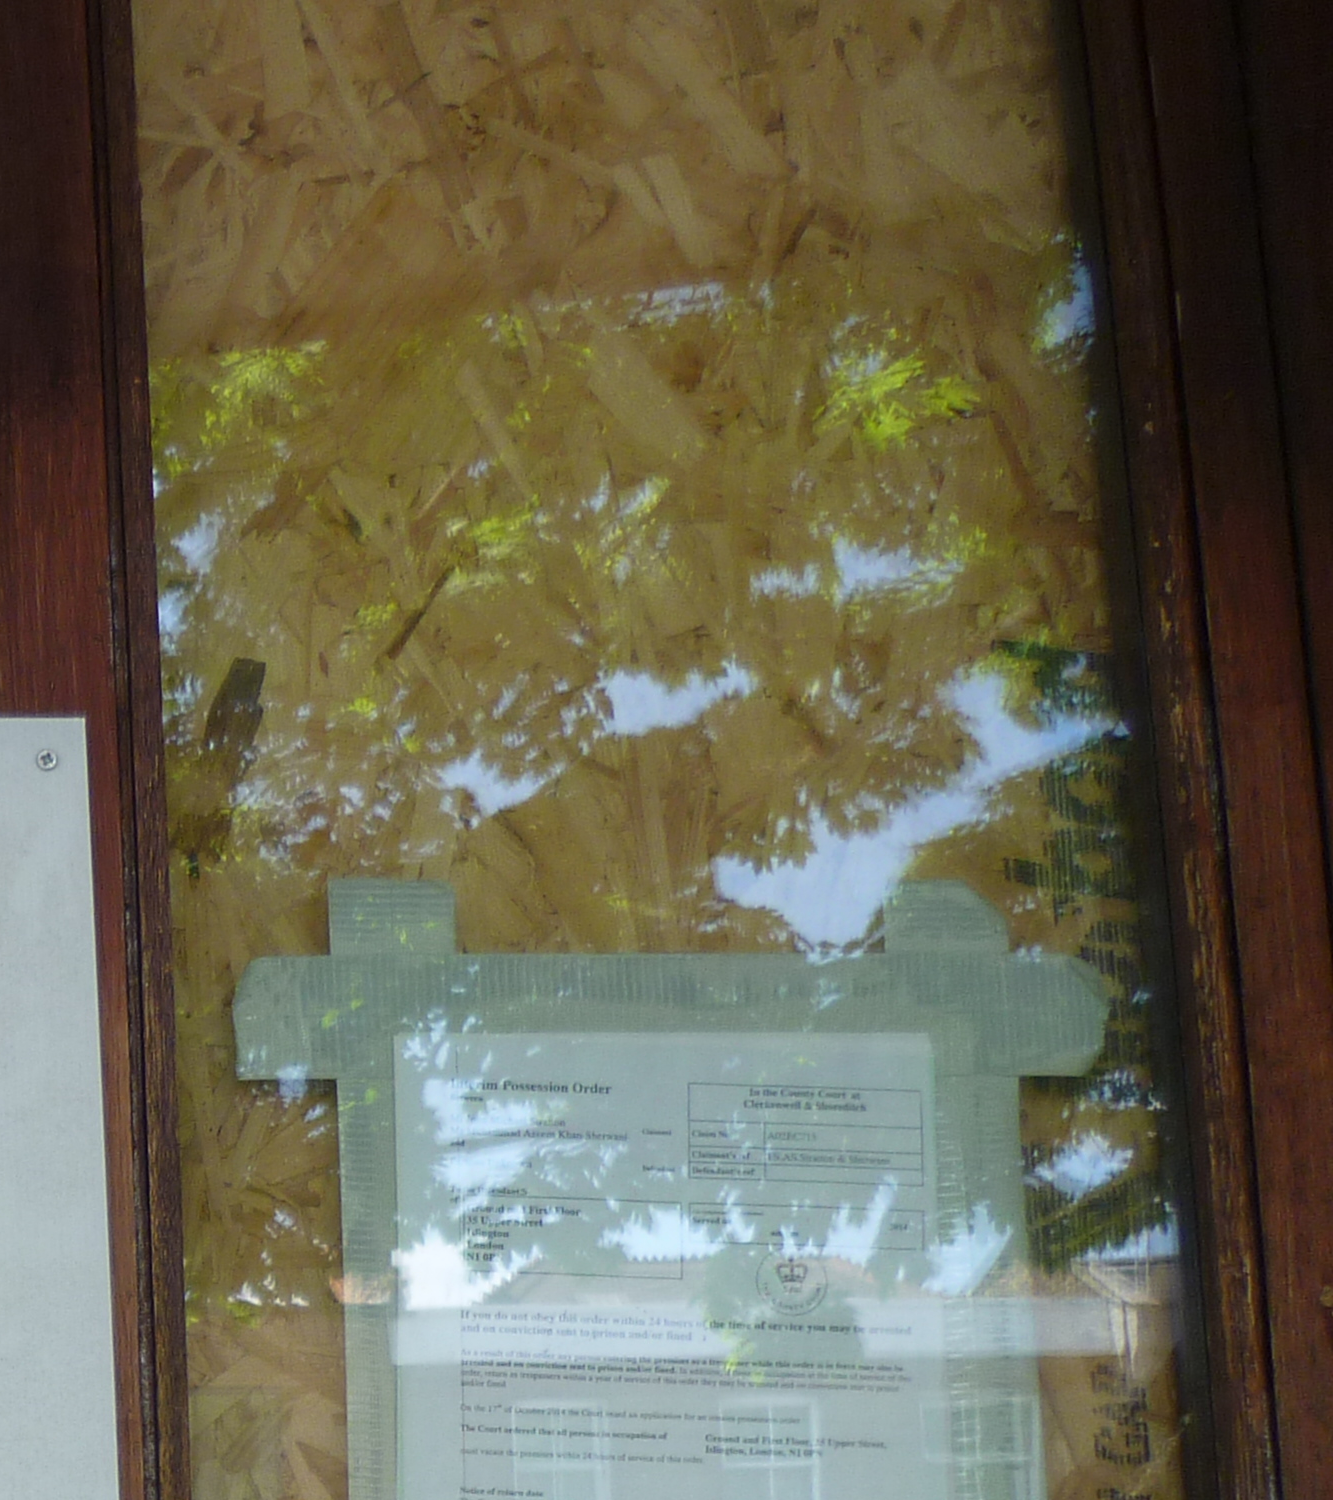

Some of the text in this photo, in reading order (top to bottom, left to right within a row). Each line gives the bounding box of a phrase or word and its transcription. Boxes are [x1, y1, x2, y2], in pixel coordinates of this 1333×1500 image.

[503, 1080, 568, 1093] Possession
[572, 1082, 613, 1094] Order
[754, 1320, 767, 1330] of
[806, 1323, 825, 1334] you
[828, 1324, 851, 1335] may
